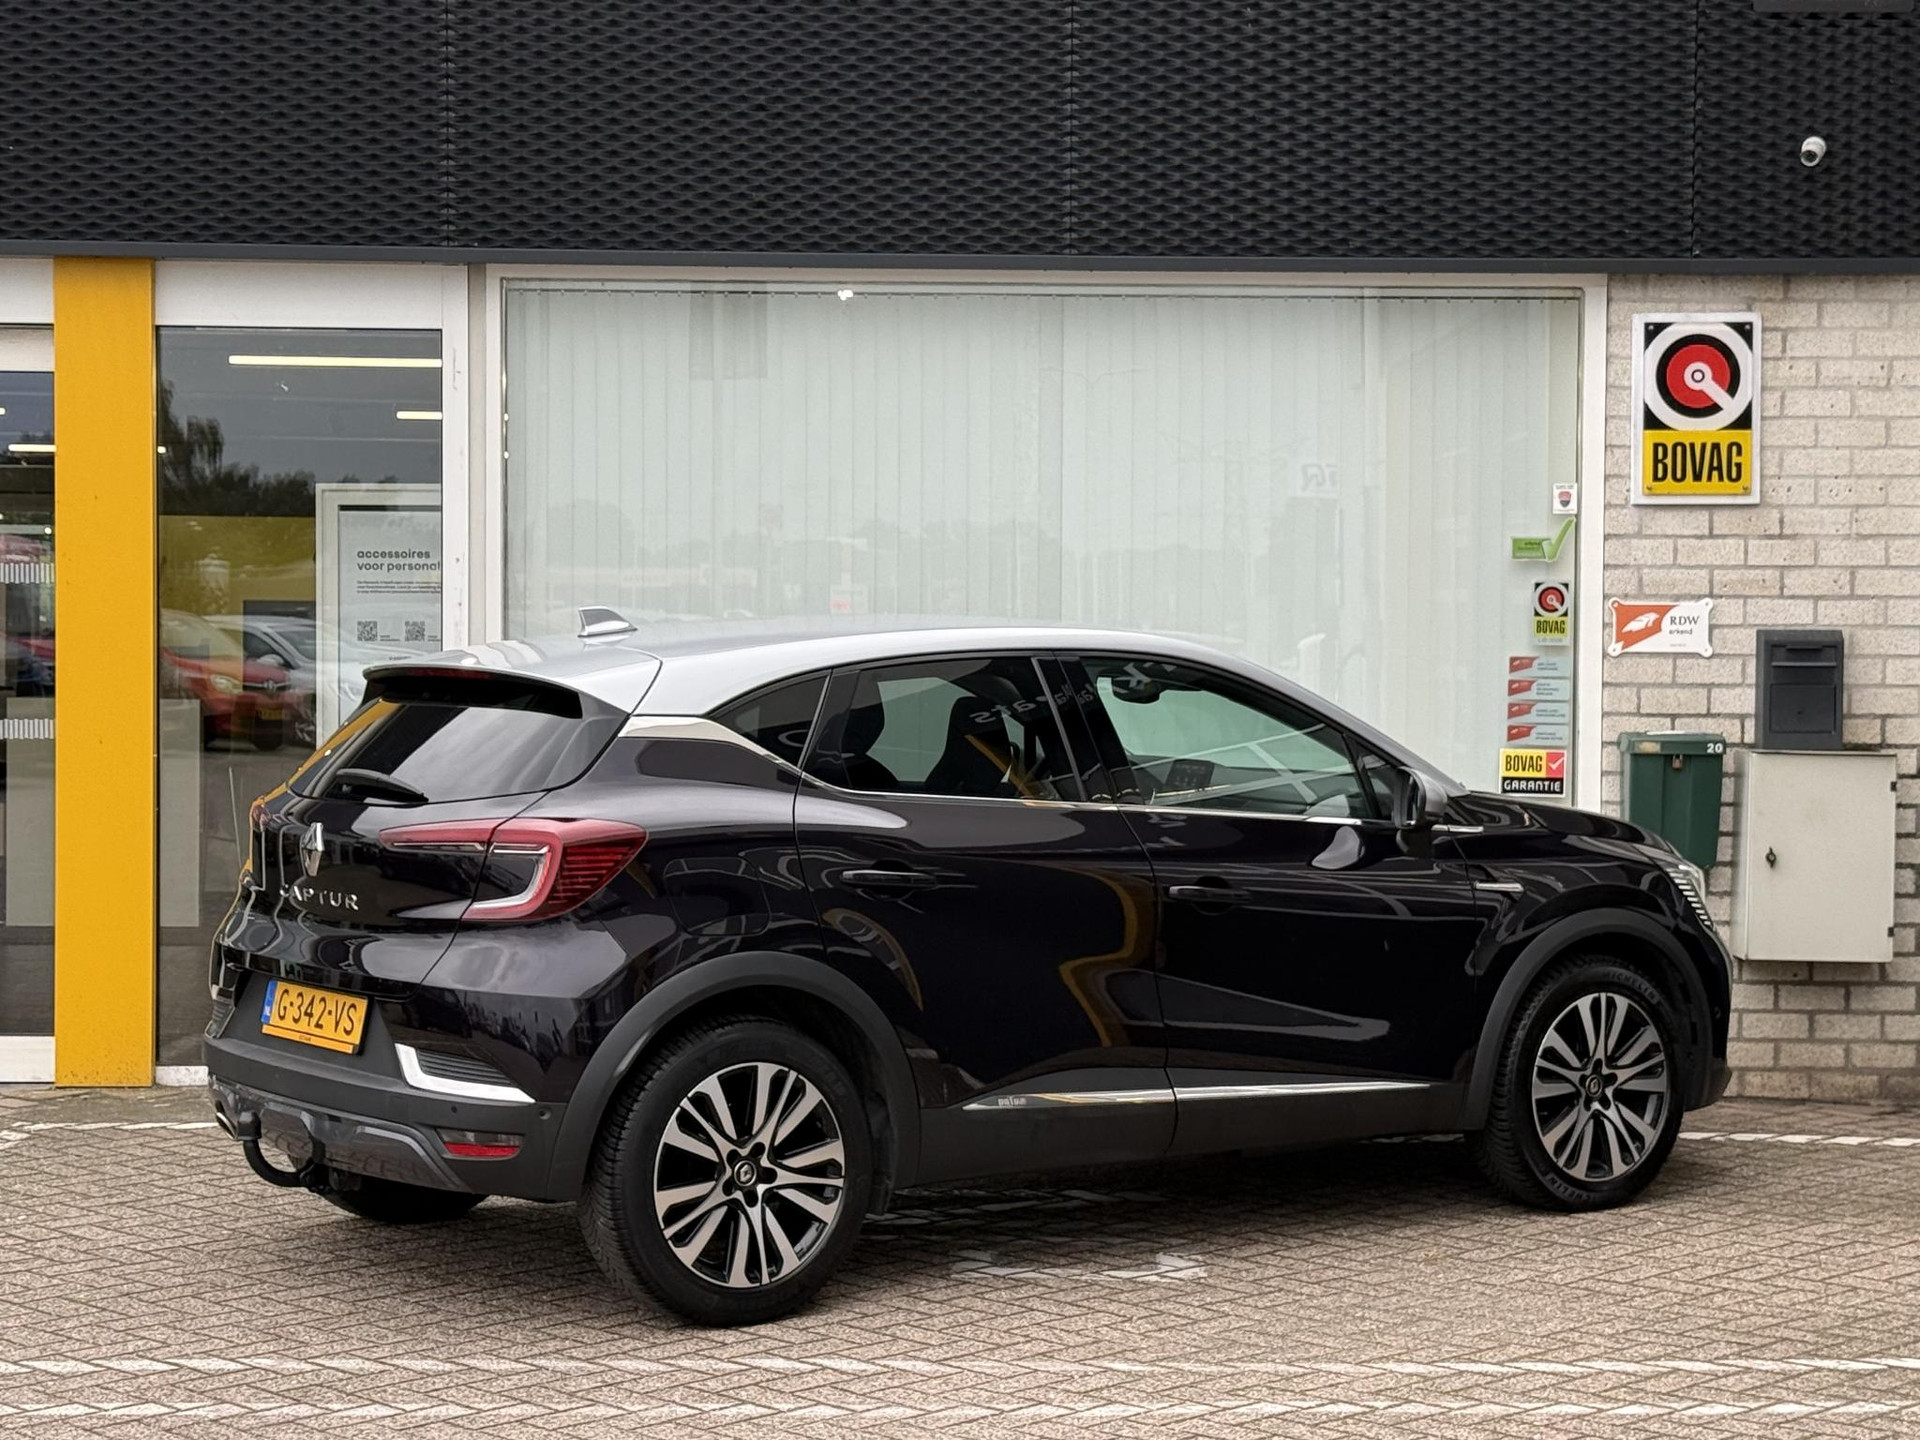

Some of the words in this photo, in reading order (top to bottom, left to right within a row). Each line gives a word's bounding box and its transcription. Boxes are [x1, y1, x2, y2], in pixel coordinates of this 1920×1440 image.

[1652, 441, 1743, 483] BOVAG
[356, 548, 431, 559] accessoires
[356, 562, 385, 571] voor
[1536, 619, 1566, 634] BOVAG
[1669, 615, 1700, 626] RDW
[1706, 743, 1724, 754] 20
[1504, 754, 1543, 773] BOVAG
[1503, 779, 1562, 792] GARANTIE
[279, 883, 360, 911] CAPTUR
[277, 988, 357, 1036] G-342-VS
